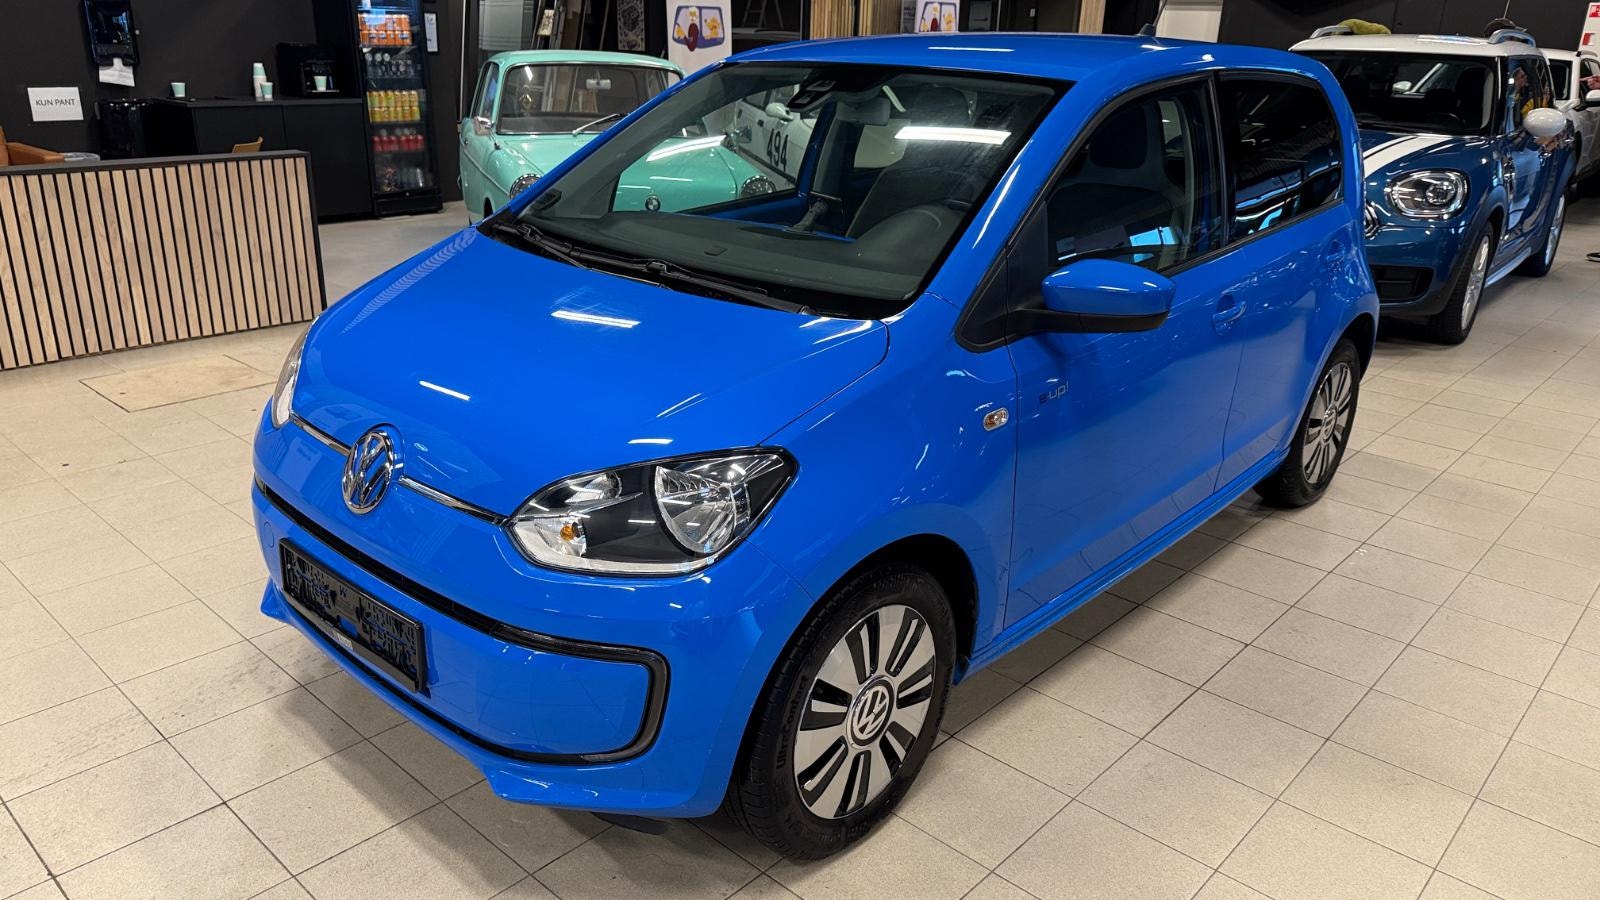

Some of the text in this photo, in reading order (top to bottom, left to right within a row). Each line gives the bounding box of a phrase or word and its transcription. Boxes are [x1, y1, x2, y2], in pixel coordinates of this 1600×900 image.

[55, 98, 75, 106] PANT
[766, 128, 789, 172] 494
[776, 675, 809, 769] UltraContact
